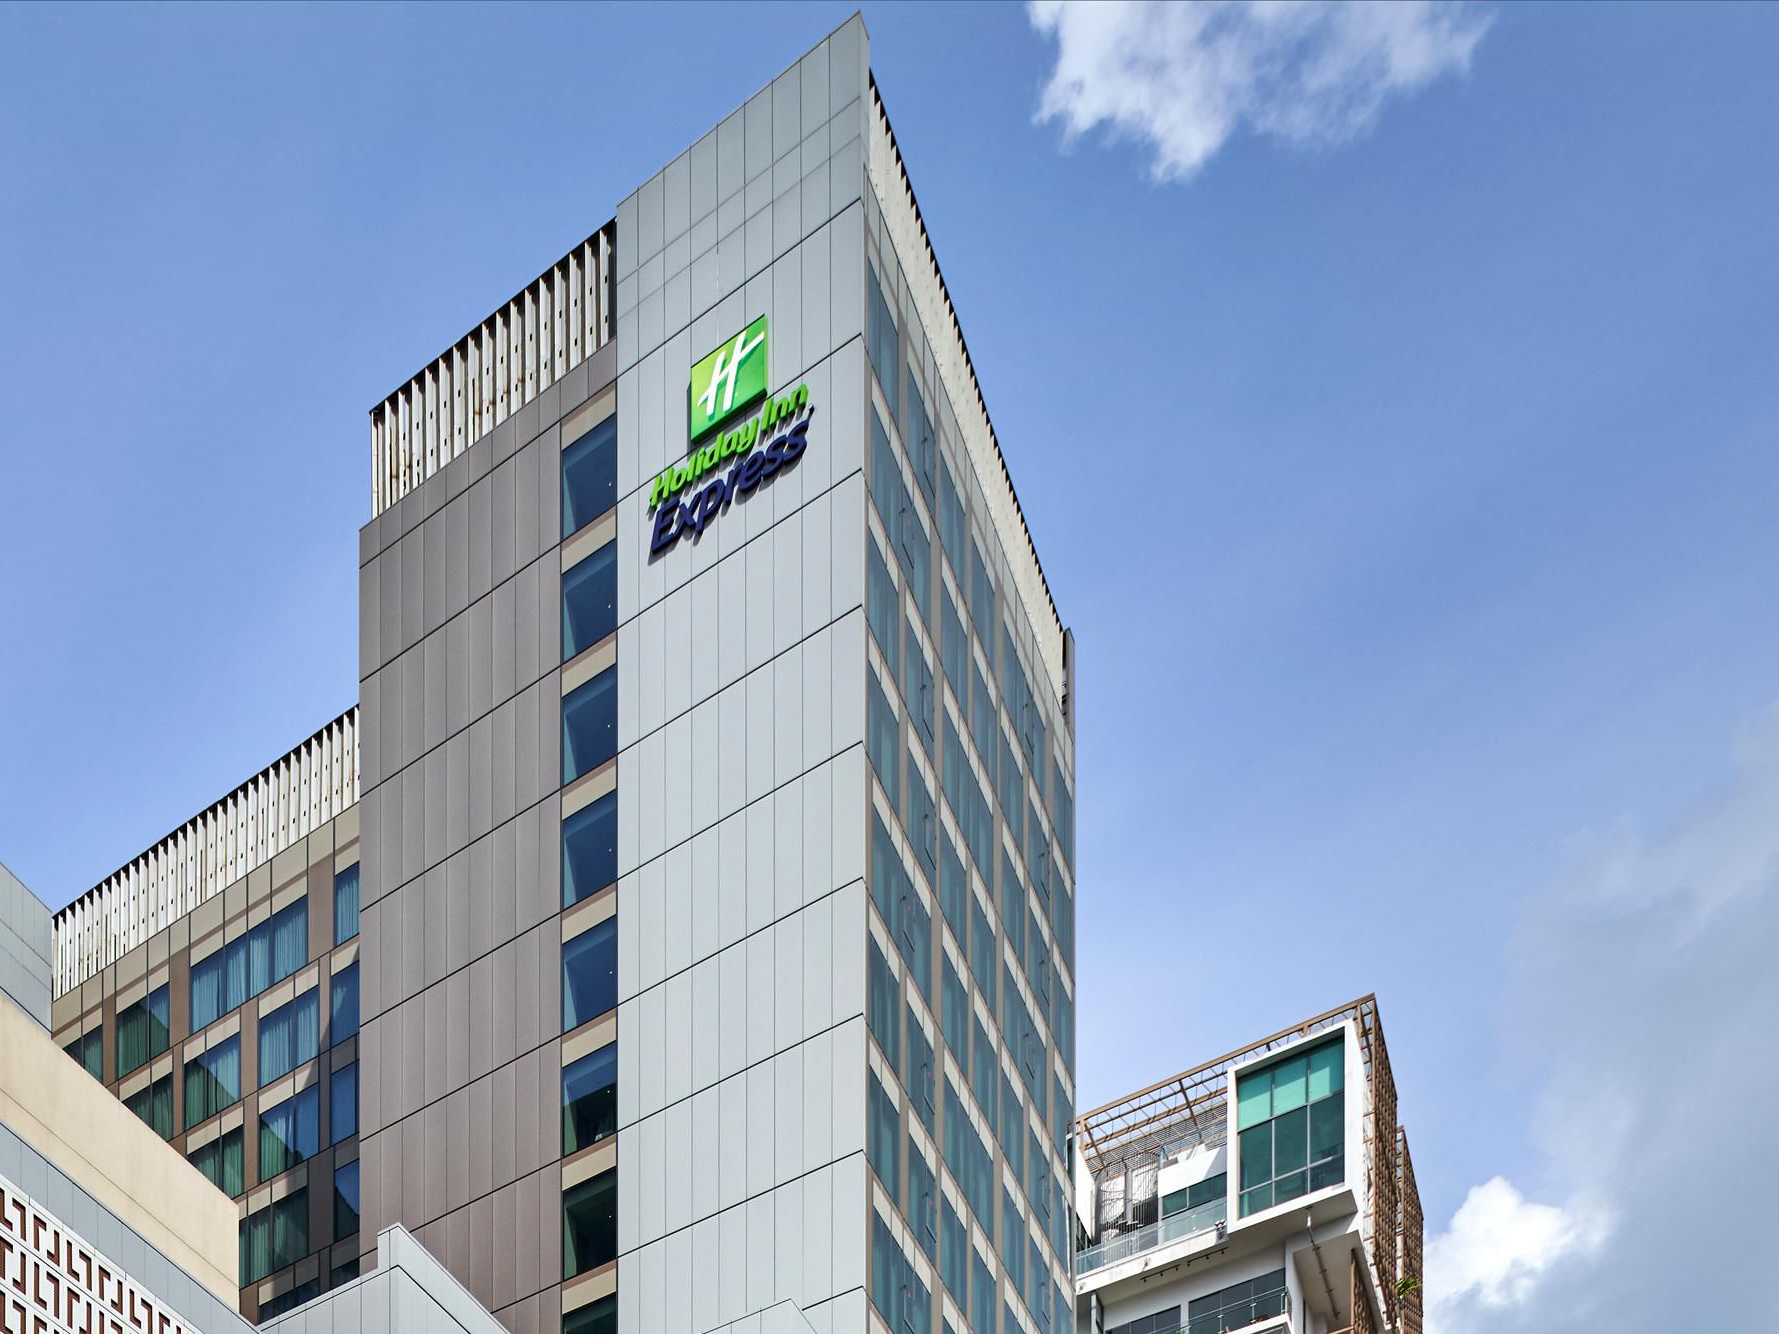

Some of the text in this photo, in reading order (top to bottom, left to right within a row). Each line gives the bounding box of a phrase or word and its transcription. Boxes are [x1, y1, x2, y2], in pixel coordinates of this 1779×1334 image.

[649, 383, 810, 509] Holiday Inn
[650, 404, 815, 554] Express
